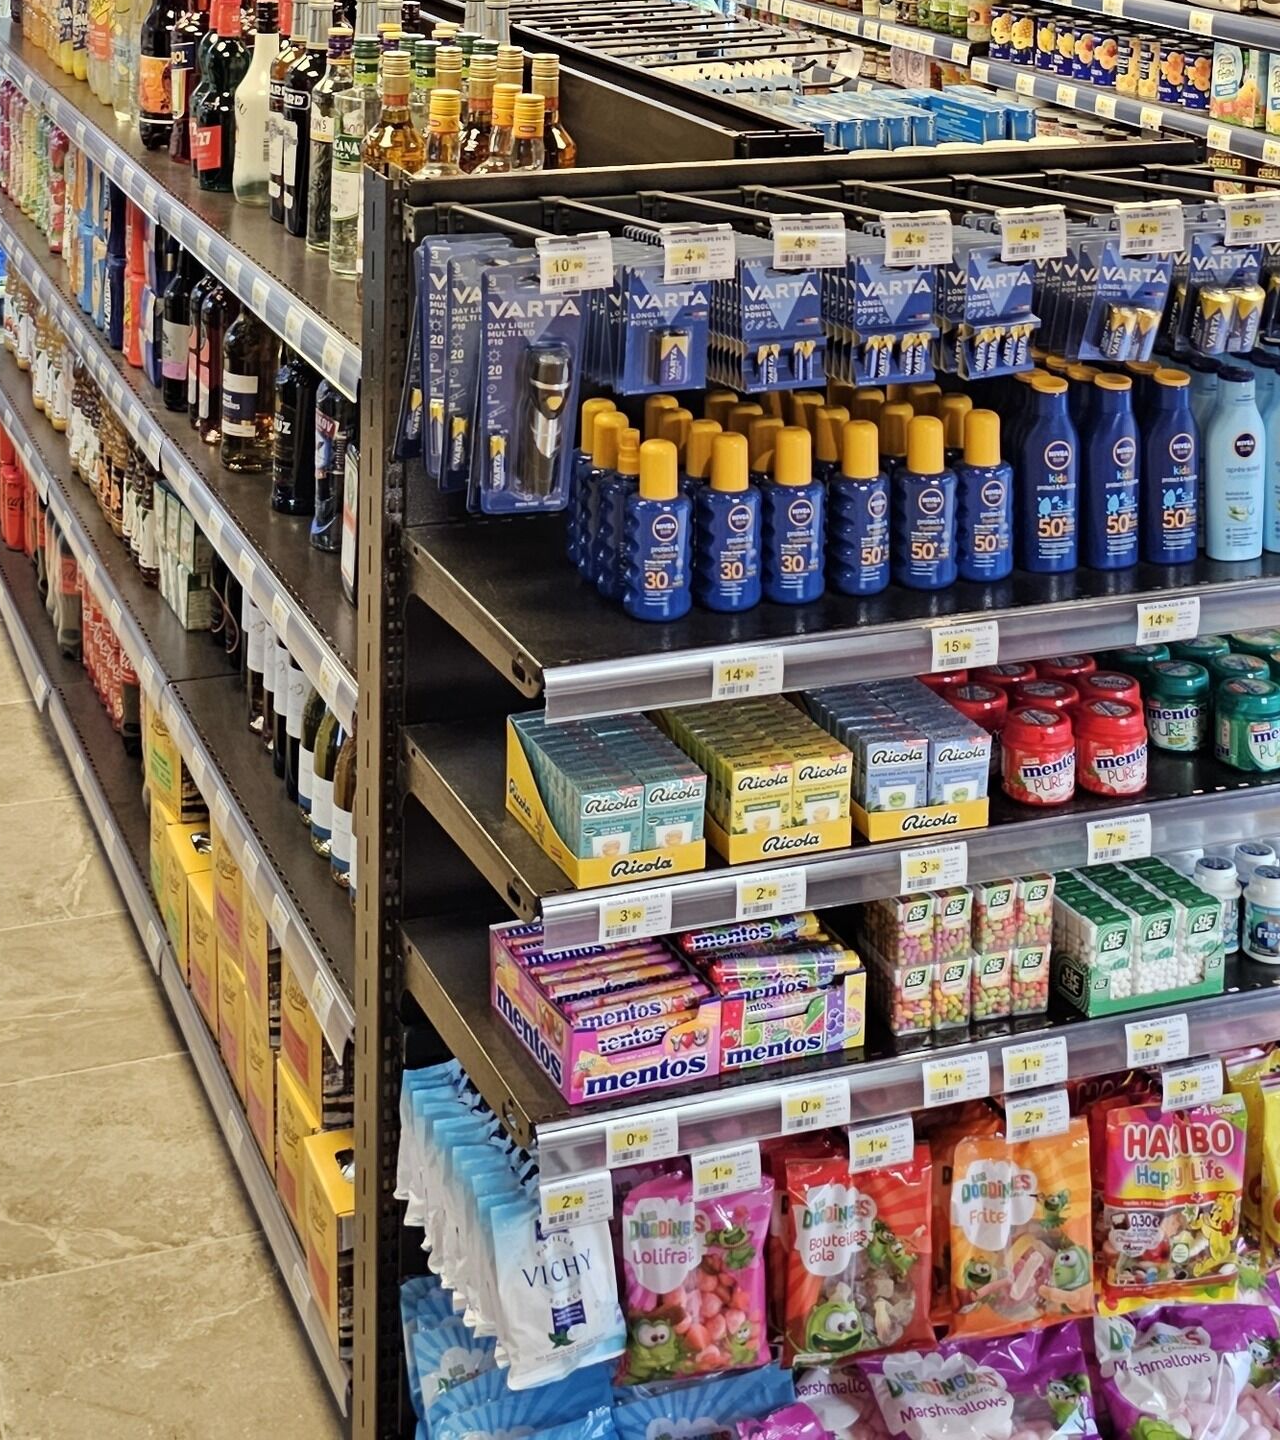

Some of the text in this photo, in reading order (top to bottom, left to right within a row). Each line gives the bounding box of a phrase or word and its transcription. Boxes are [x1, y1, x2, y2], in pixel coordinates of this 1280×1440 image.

[1192, 253, 1258, 271] VARTA
[970, 271, 1032, 292] VARTA
[1102, 266, 1168, 284] VARTA
[744, 281, 818, 301] VARTA
[858, 278, 932, 297] VARTA
[487, 299, 581, 319] VARTA
[632, 290, 708, 310] VARTA
[744, 310, 772, 319] POWER
[857, 306, 884, 315] POWER
[487, 322, 507, 330] DAY
[487, 330, 516, 339] MULTI
[1206, 310, 1222, 349] VARTA
[1242, 310, 1259, 347] VARTA
[429, 334, 444, 346] 20
[450, 349, 464, 360] 20
[668, 346, 678, 381] VARTA
[487, 364, 503, 376] 20
[720, 562, 744, 580] 30
[780, 555, 805, 572] 30
[644, 571, 669, 589] 30
[871, 747, 923, 765] Ricola
[938, 745, 986, 763] Ricola
[798, 762, 848, 781] Ricola
[1107, 768, 1137, 785] PURE
[737, 774, 789, 792] Ricola
[1033, 777, 1065, 793] PURE
[648, 785, 701, 803] Ricola
[584, 797, 639, 815] Ricola
[901, 812, 958, 832] Ricola
[762, 832, 821, 853] Ricola
[610, 856, 673, 878] Ricola
[692, 923, 773, 949] mentos
[581, 998, 662, 1029] mentos
[496, 983, 563, 1087] mentos
[725, 1035, 822, 1067] mentos
[584, 1055, 707, 1097] mentos
[1189, 1159, 1225, 1183] Life
[808, 1251, 835, 1264] cola
[521, 1248, 592, 1288] VICHY
[899, 1396, 1009, 1424] Marshmallows
